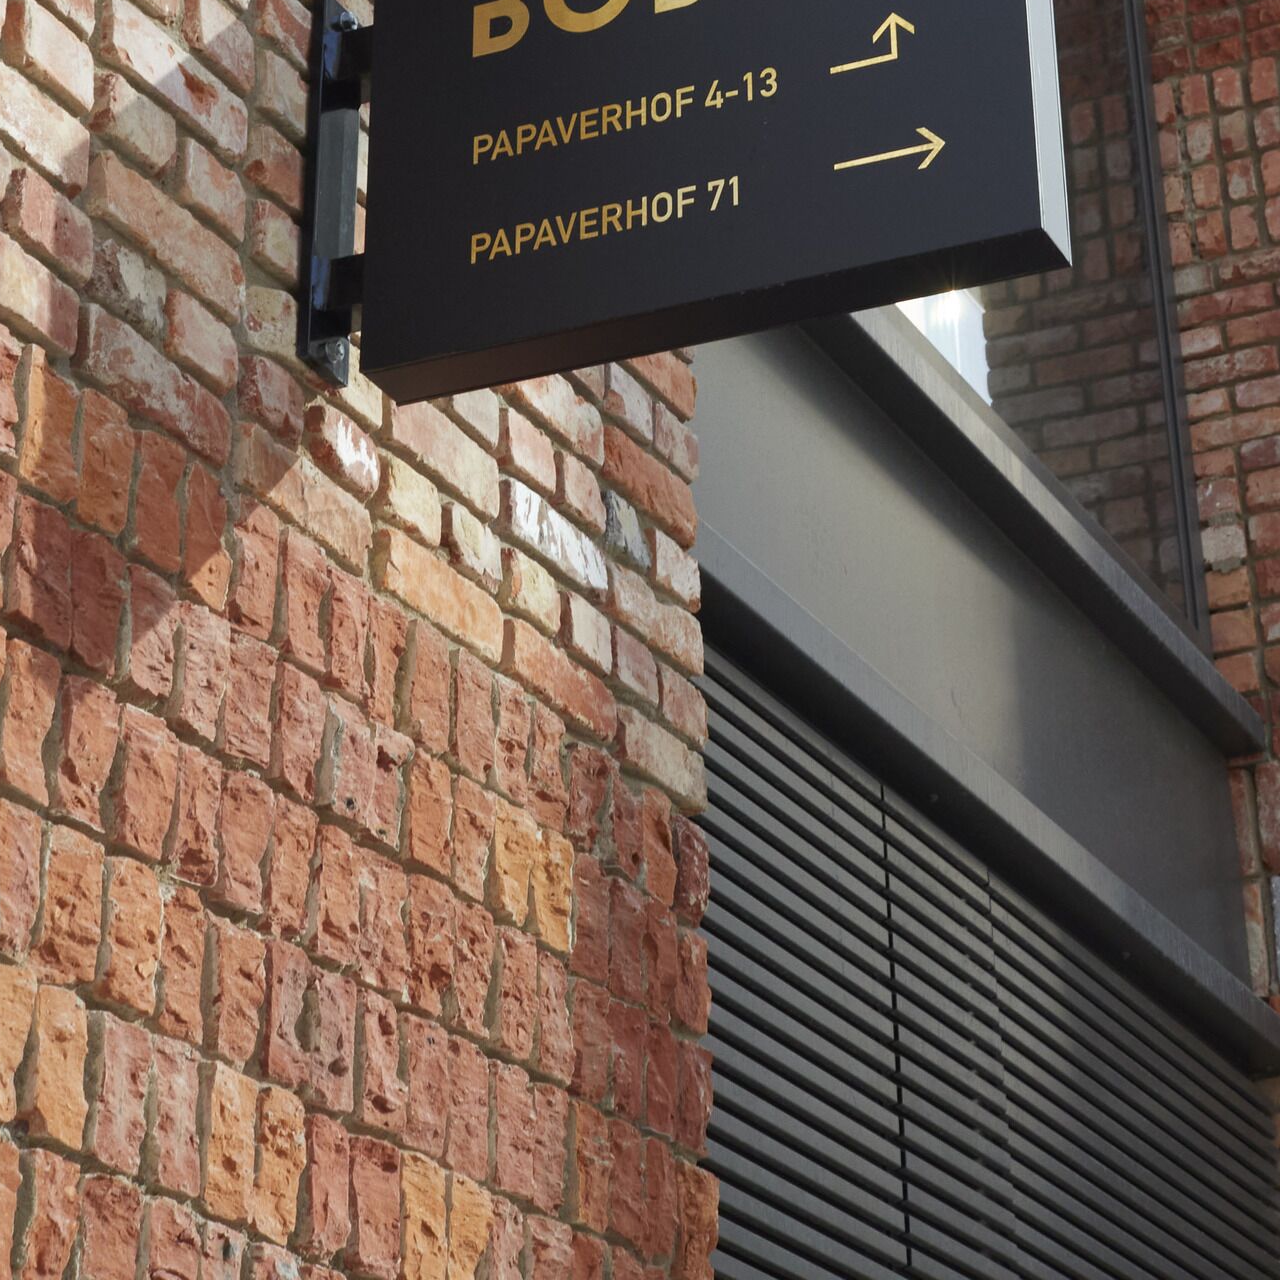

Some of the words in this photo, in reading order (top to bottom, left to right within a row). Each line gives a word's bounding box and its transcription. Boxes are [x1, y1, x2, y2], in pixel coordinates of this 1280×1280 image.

[472, 85, 696, 165] PAPAVERHOF
[704, 67, 779, 110] 4-13
[470, 185, 697, 265] PAPAVERHOF
[707, 175, 740, 212] 71
